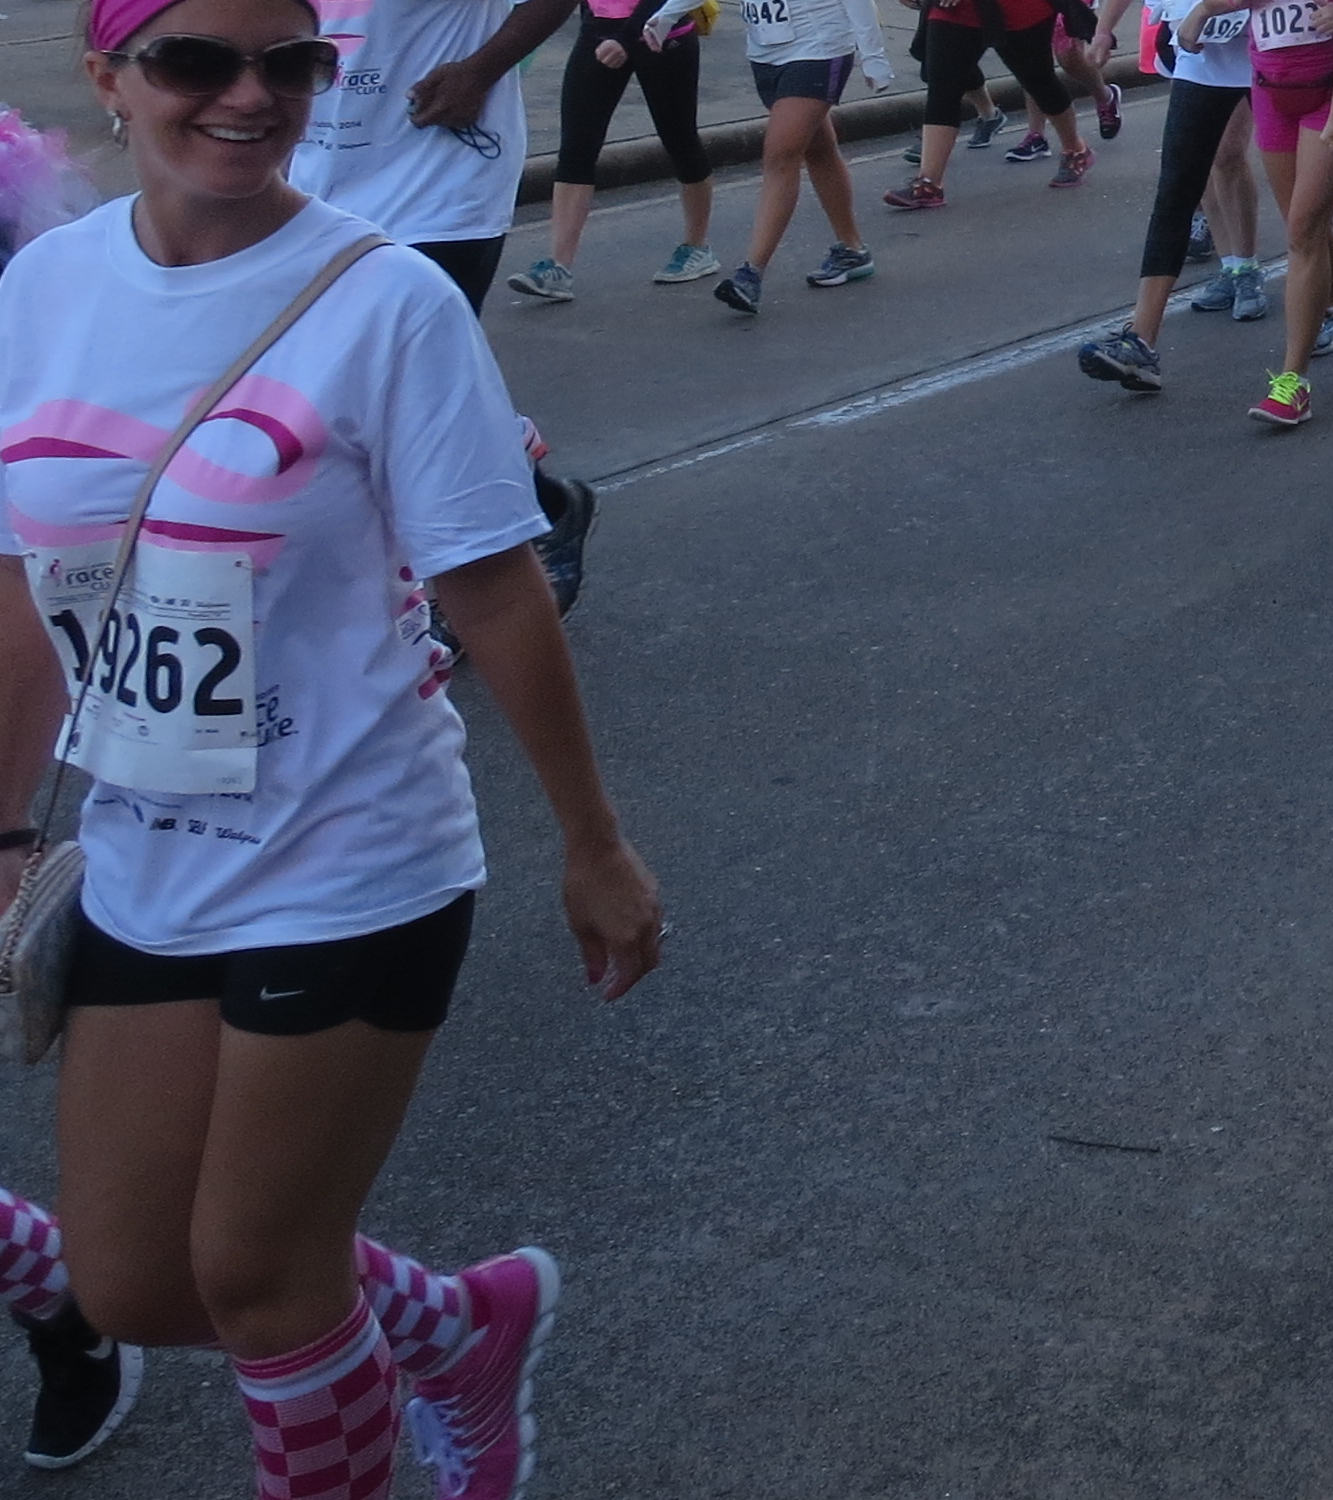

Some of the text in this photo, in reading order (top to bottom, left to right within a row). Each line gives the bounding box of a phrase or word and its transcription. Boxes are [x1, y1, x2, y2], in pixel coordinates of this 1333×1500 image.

[341, 73, 380, 87] race
[65, 562, 115, 586] race
[49, 608, 244, 717] 19262
